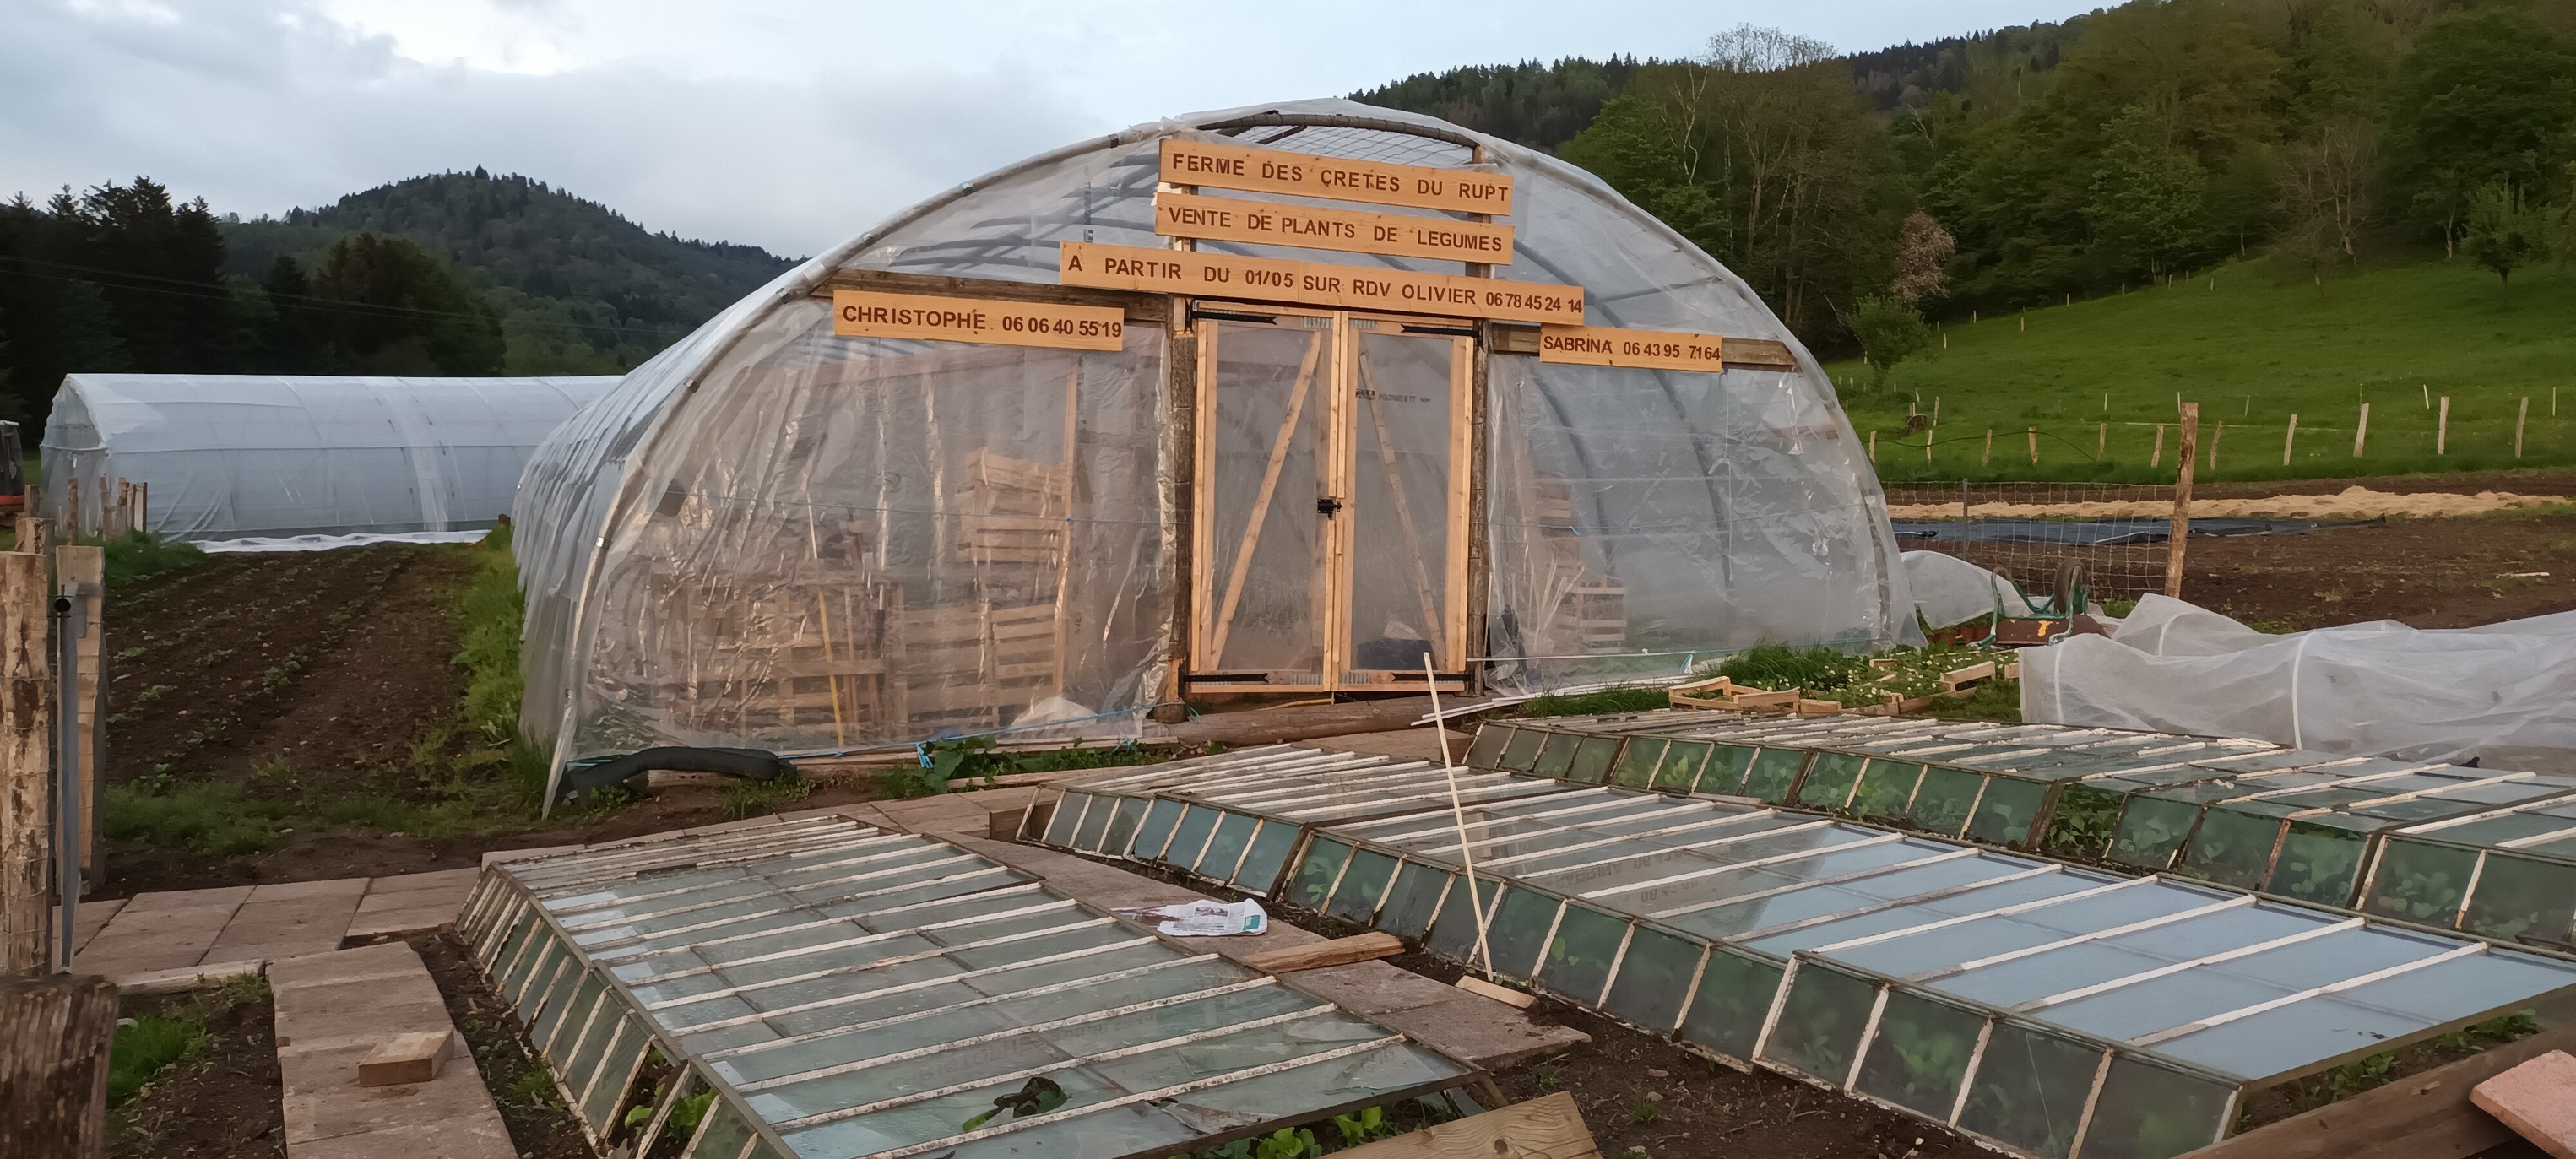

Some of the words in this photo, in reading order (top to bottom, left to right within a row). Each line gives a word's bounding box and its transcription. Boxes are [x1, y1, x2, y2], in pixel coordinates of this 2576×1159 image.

[1173, 153, 1245, 176] FERME
[1261, 162, 1303, 181] DES
[1320, 169, 1400, 192] CRETES
[1418, 179, 1443, 196] DU
[1458, 182, 1509, 202] RUPT
[1169, 206, 1232, 228] VENTE
[1247, 214, 1272, 231] DE
[1282, 217, 1355, 239] PLANTS
[1374, 225, 1398, 243] DE
[1418, 230, 1502, 252] LEGUMES
[1067, 254, 1082, 272] A
[1105, 257, 1182, 279] PARTIR
[1204, 266, 1231, 284] DU
[1245, 269, 1293, 288] 01/05
[1303, 275, 1341, 293] SUR
[1353, 279, 1391, 297] RDV
[1402, 284, 1476, 305] OLIVIER
[1485, 291, 1503, 307] 06
[1505, 293, 1522, 309] 78
[1524, 295, 1543, 311] 45
[1544, 296, 1562, 311] 24
[1567, 298, 1583, 313] 14
[843, 305, 986, 330] CHRISTOPHE
[1002, 316, 1024, 332] 06
[1028, 317, 1049, 333] 06
[1052, 318, 1074, 335] 40
[1543, 335, 1613, 355] SABRINA
[1623, 341, 1641, 356] 06
[1643, 343, 1661, 357] 43
[1663, 344, 1680, 358] 95
